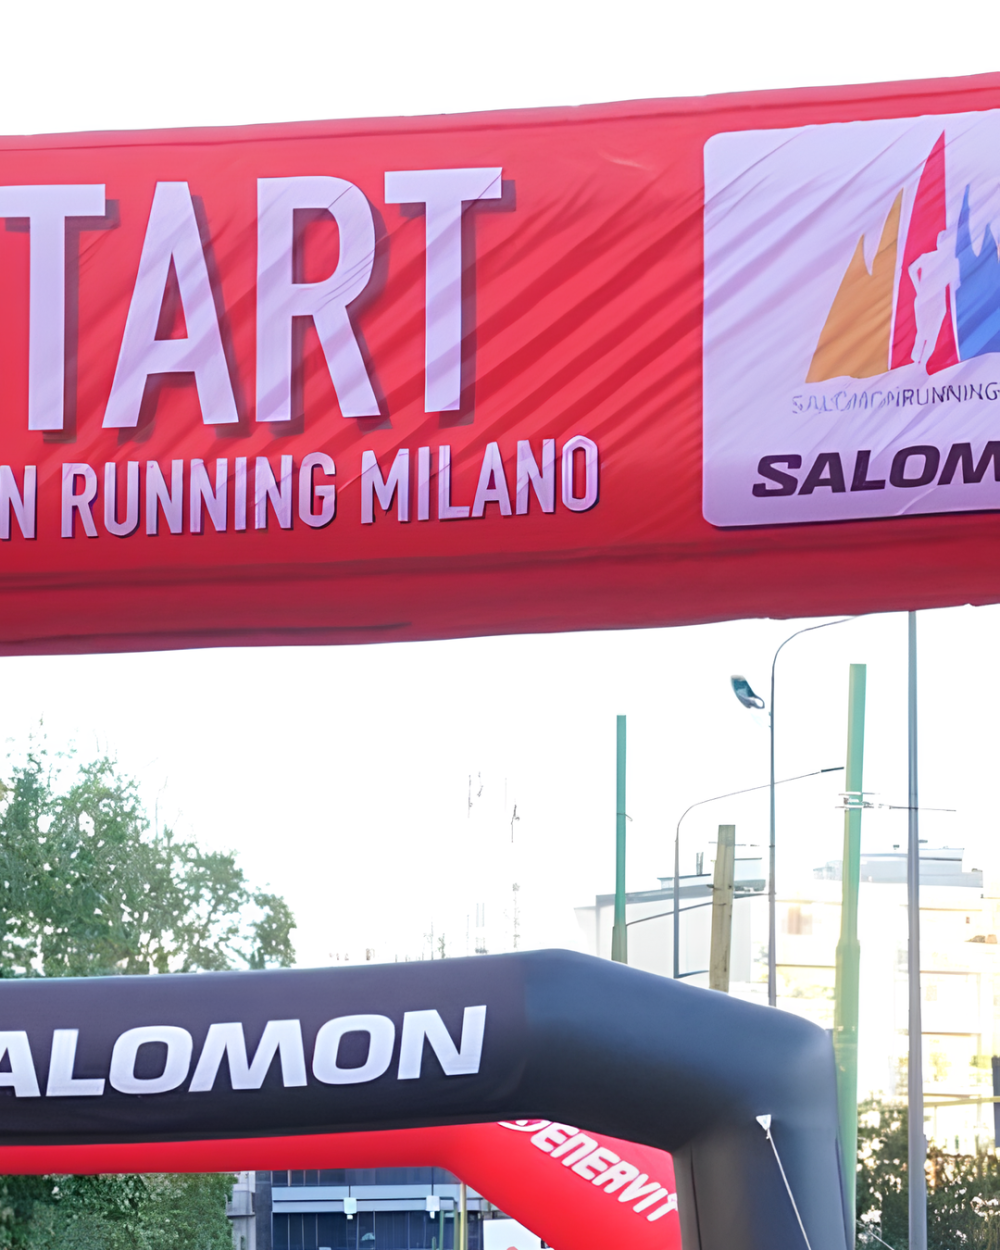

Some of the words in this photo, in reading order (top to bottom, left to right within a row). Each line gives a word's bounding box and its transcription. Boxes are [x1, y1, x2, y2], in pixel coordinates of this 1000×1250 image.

[61, 452, 336, 540] RUNNING
[361, 434, 600, 525] MILANO
[752, 441, 1000, 498] SALOM
[530, 1122, 679, 1222] ENERVIT
